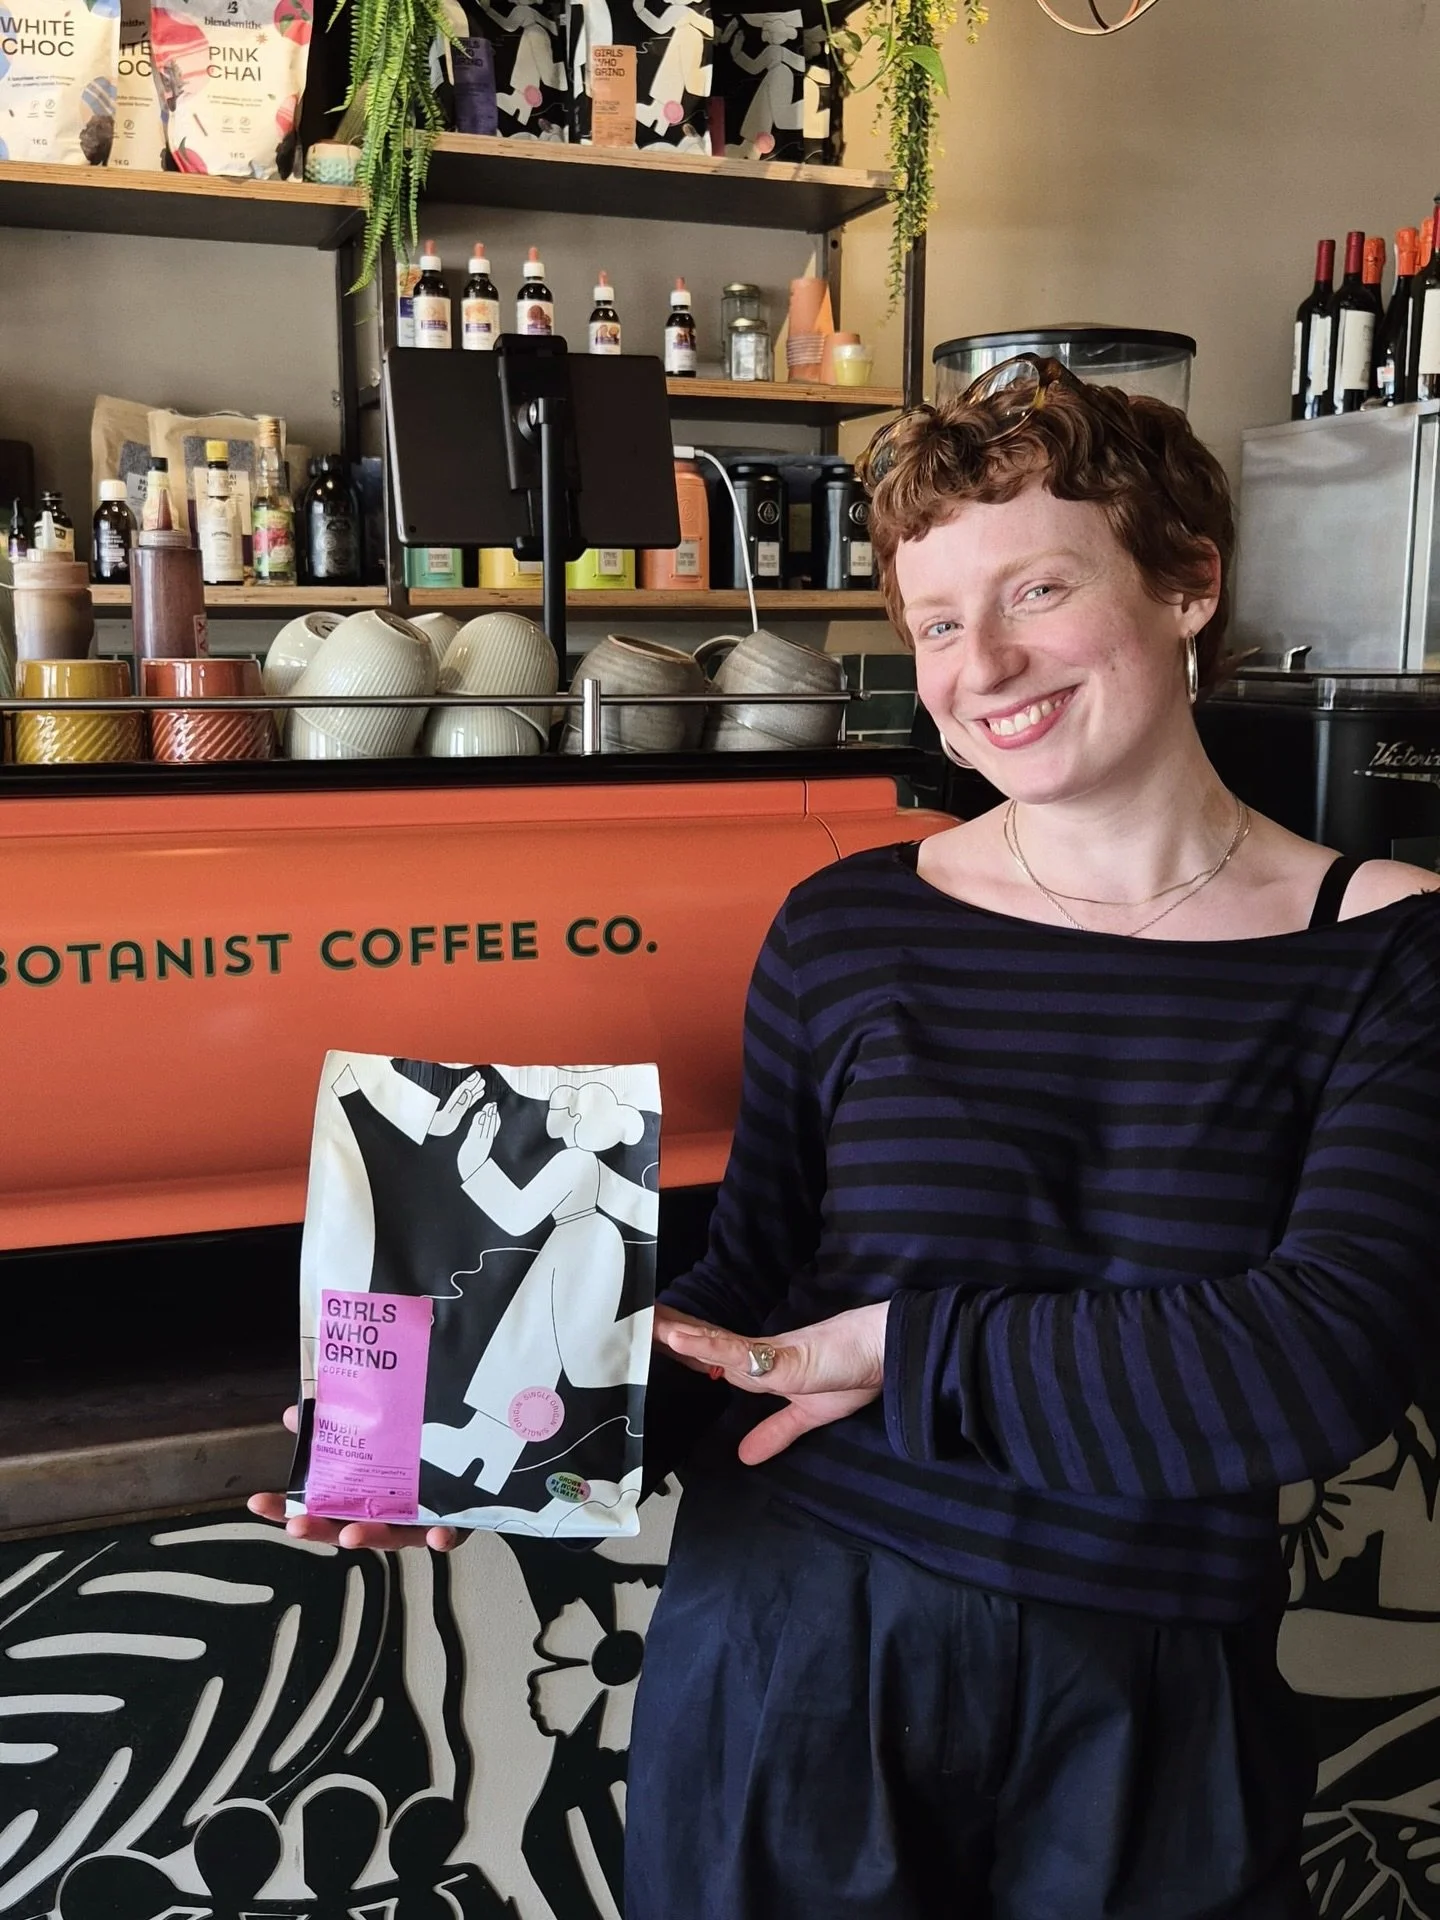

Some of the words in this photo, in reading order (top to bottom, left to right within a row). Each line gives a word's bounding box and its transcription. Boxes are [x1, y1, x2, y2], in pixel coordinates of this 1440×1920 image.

[0, 16, 75, 36] WHITE
[204, 16, 262, 30] blendsmiths
[2, 38, 74, 57] CHOC
[120, 40, 151, 56] ITE
[208, 46, 259, 62] PINK
[594, 49, 624, 57] GIRLS
[118, 60, 152, 76] OC
[206, 65, 261, 81] CHAI
[594, 68, 625, 77] GRIND
[320, 921, 539, 971] COFFEE
[565, 914, 658, 958] CO.
[327, 1298, 397, 1323] GIRLS
[325, 1320, 379, 1345] WHO
[325, 1342, 398, 1370] GRIND
[322, 1364, 359, 1378] COFFEE
[523, 1391, 550, 1400] SINGLE
[550, 1399, 560, 1426] ORIGIN
[319, 1418, 358, 1436] WUBIT
[318, 1430, 367, 1449] BEKELE
[316, 1444, 343, 1456] SINGLE
[345, 1450, 373, 1461] ORIGIN
[559, 1475, 582, 1487] GROWN
